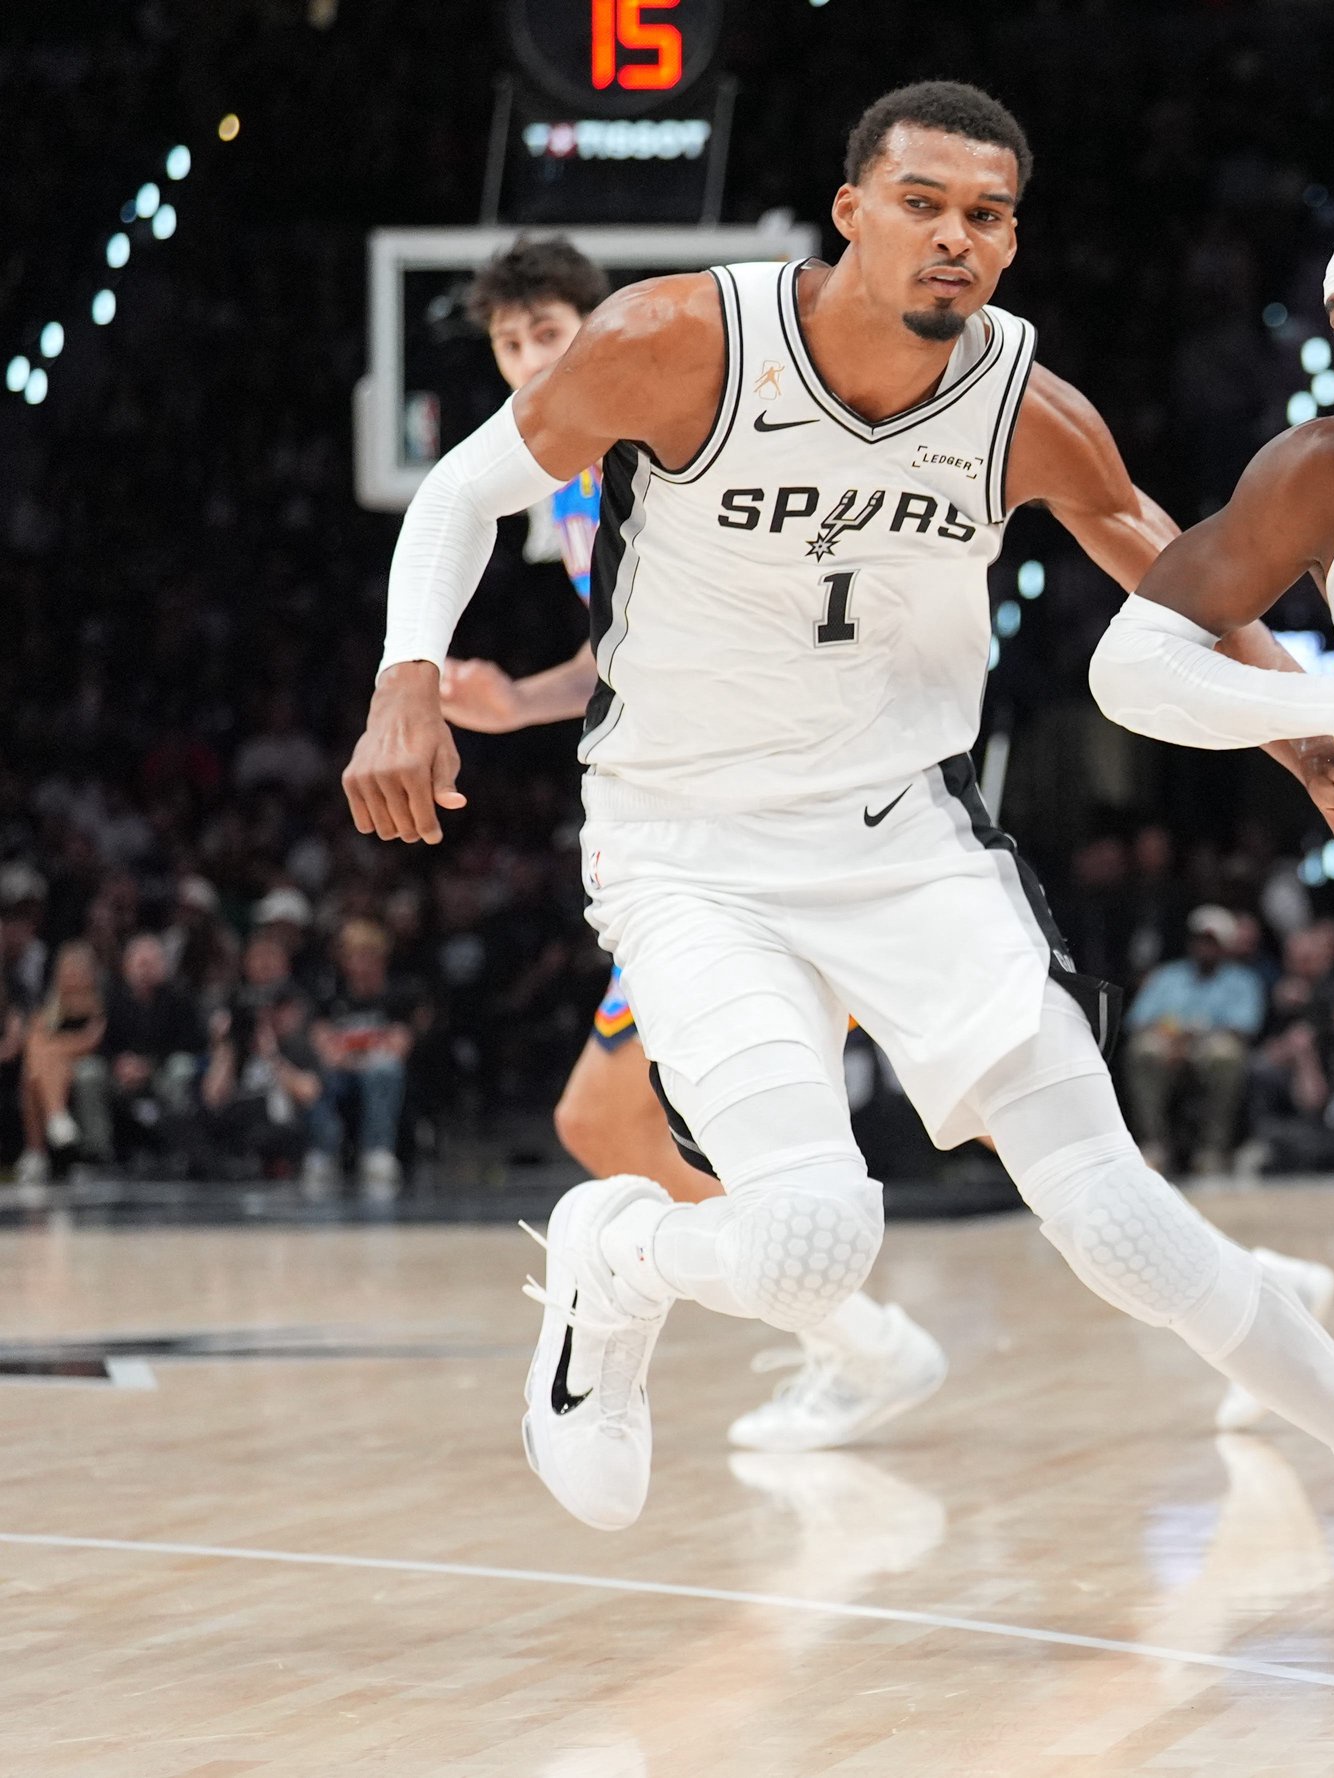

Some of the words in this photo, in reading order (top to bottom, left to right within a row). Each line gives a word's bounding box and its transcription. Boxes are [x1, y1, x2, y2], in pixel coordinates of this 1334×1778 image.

[591, 0, 682, 90] 15
[922, 453, 972, 471] LEDGER
[717, 486, 976, 563] SPURS
[812, 568, 861, 648] 1
